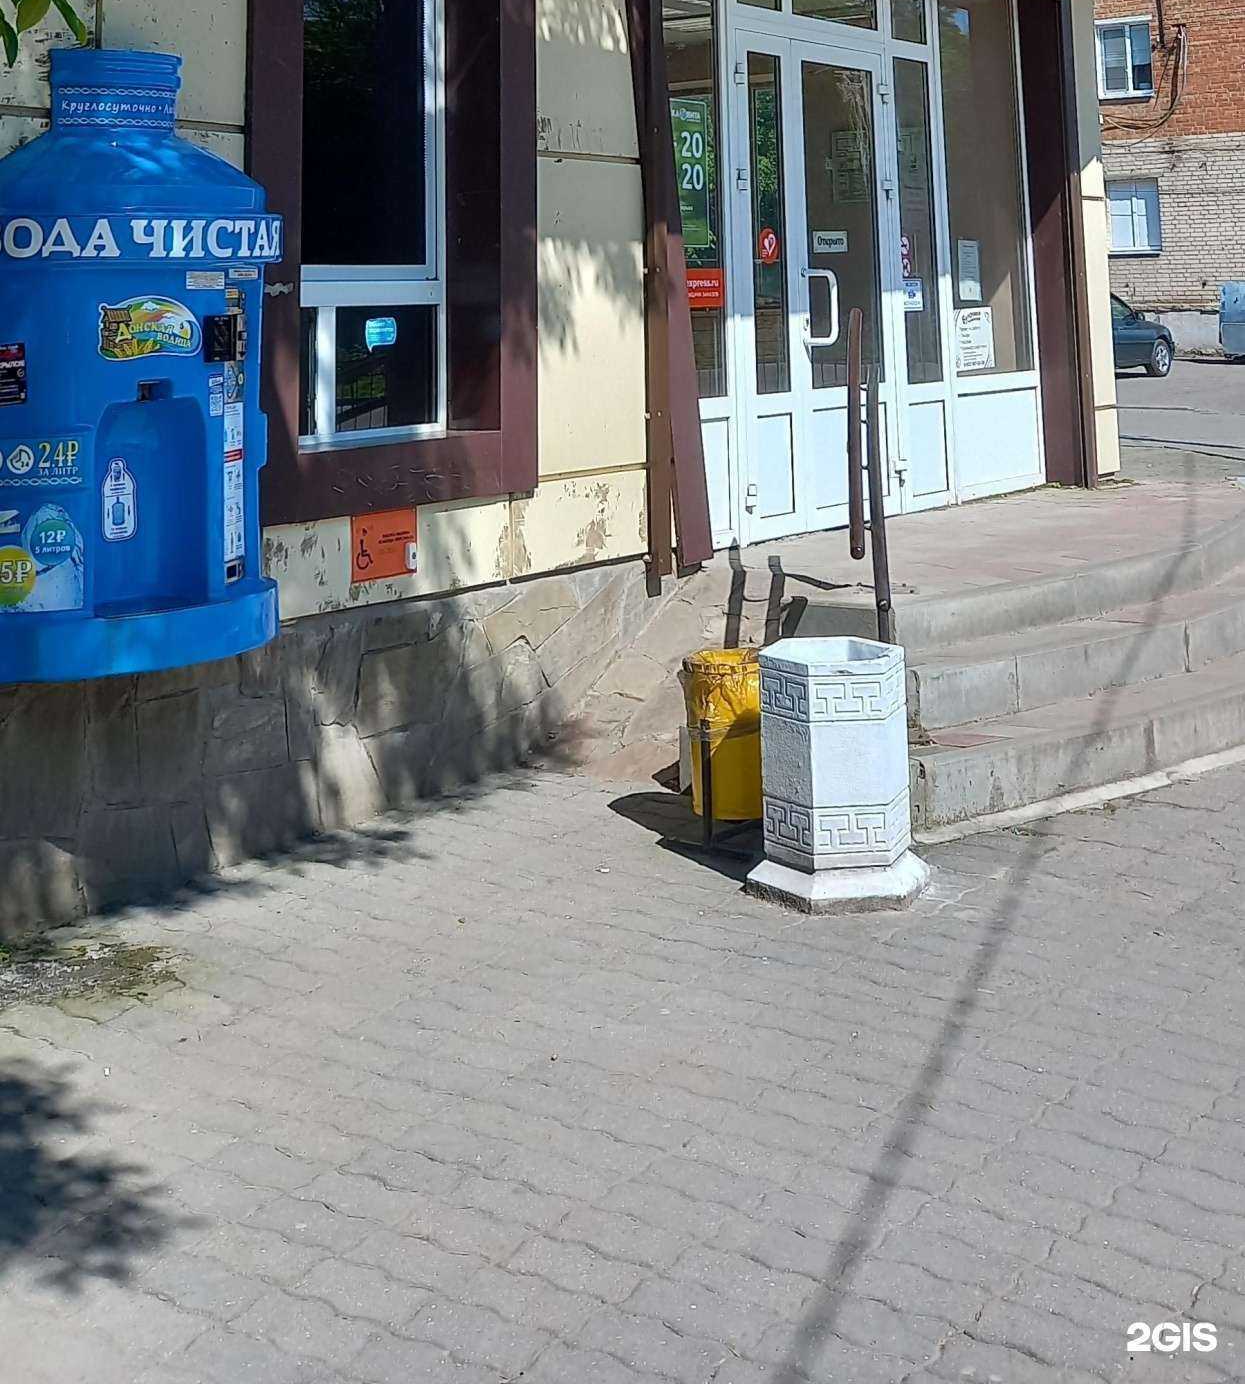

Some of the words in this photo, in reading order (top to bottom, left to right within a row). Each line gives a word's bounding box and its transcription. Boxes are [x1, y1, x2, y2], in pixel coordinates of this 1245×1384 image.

[61, 99, 156, 114] Круглосуточно
[681, 130, 703, 158] 20
[682, 163, 704, 191] 20
[0, 217, 121, 258] ОДА
[130, 218, 280, 258] ЧИСТАЯ
